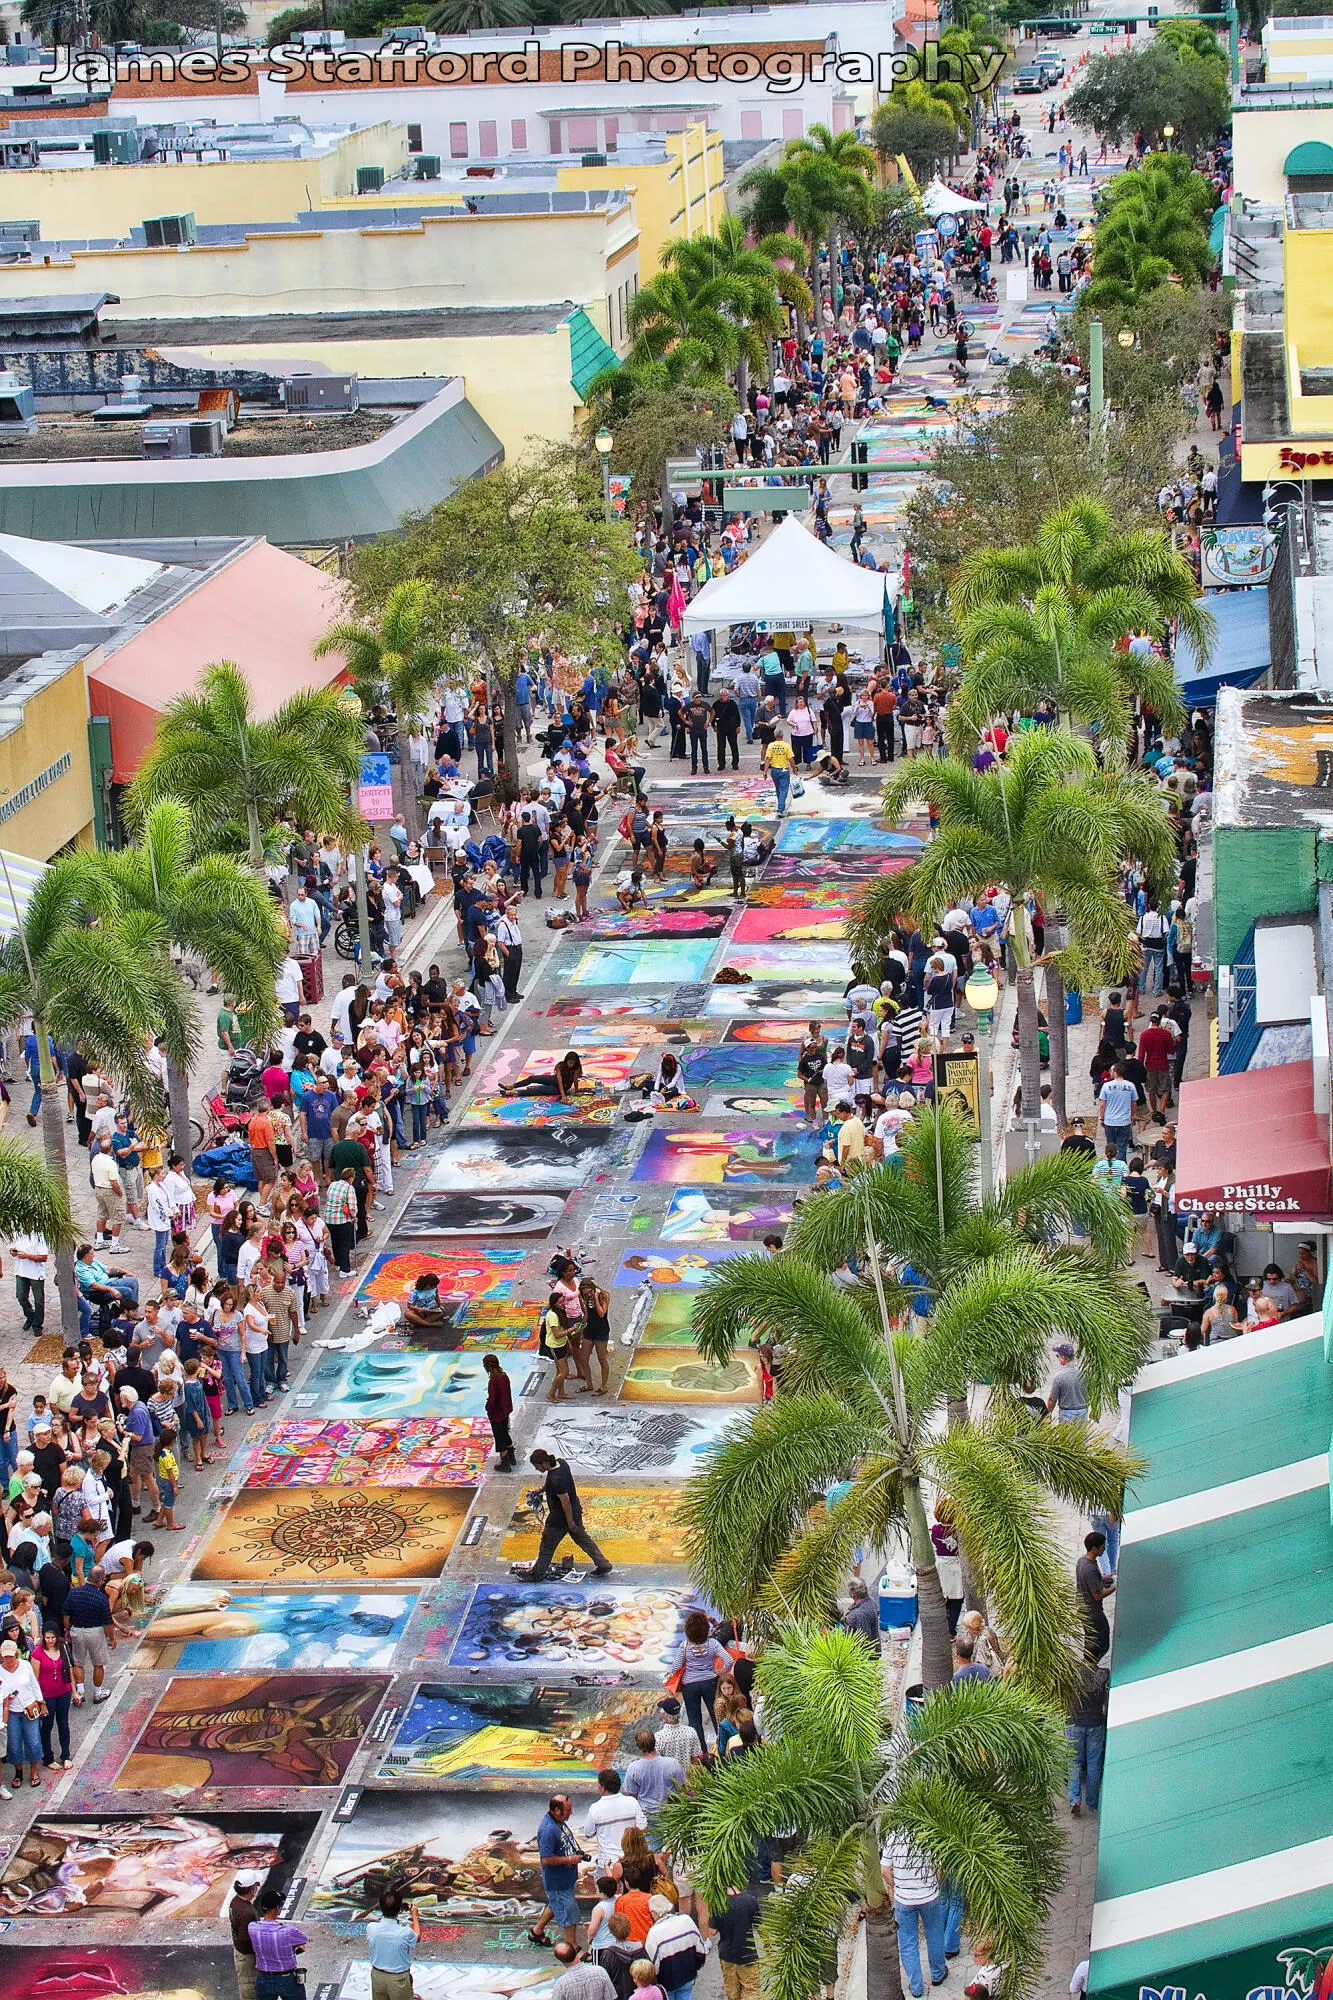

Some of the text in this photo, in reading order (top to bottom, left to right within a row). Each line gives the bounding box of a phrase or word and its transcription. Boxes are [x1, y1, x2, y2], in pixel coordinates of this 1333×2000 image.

[769, 620, 809, 630] T-SHIRT SALES
[947, 1061, 969, 1069] STREET
[948, 1069, 976, 1078] PAINTING
[949, 1077, 974, 1086] FESTIVAL
[1222, 1184, 1283, 1199] Philly
[1178, 1198, 1301, 1211] CheeseSteak
